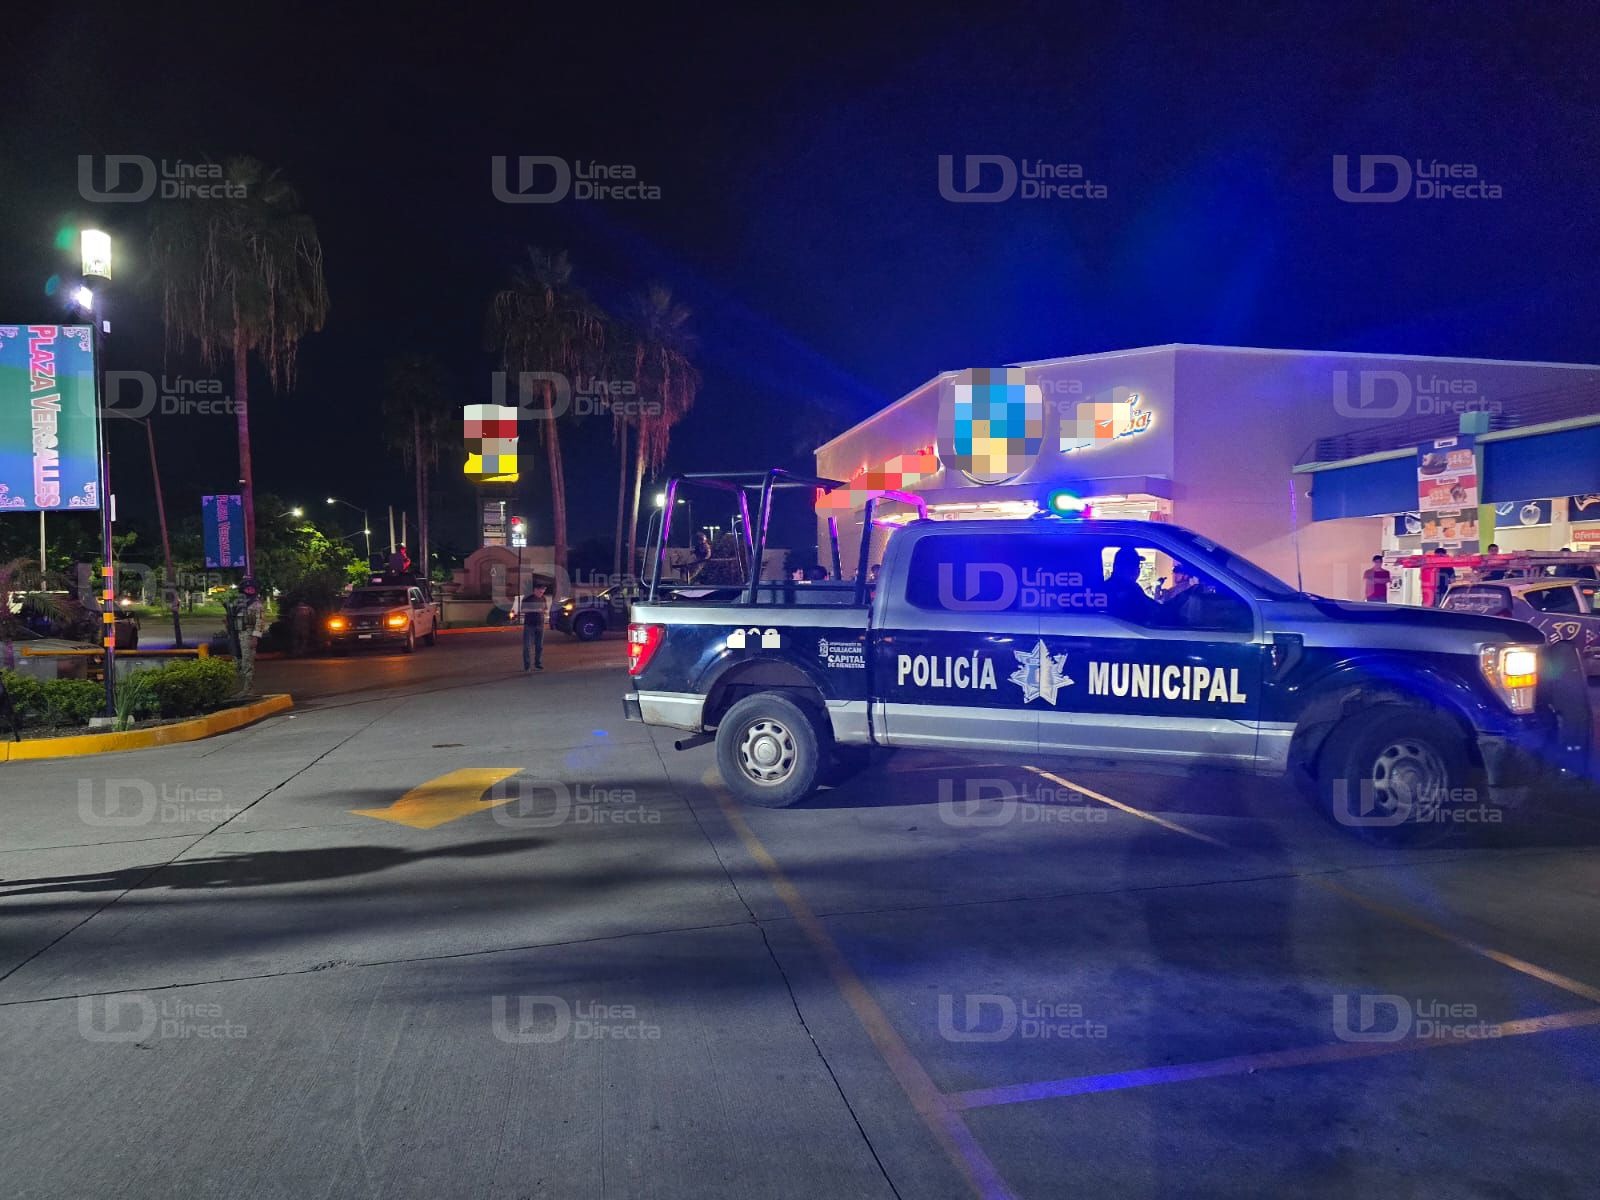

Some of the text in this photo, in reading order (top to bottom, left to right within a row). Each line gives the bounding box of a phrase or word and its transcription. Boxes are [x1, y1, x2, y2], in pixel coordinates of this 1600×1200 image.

[28, 325, 61, 507] PLAZA VERSALLES
[827, 655, 866, 664] CAPITAL
[897, 650, 1247, 703] POLICÍA MUNICIPAL
